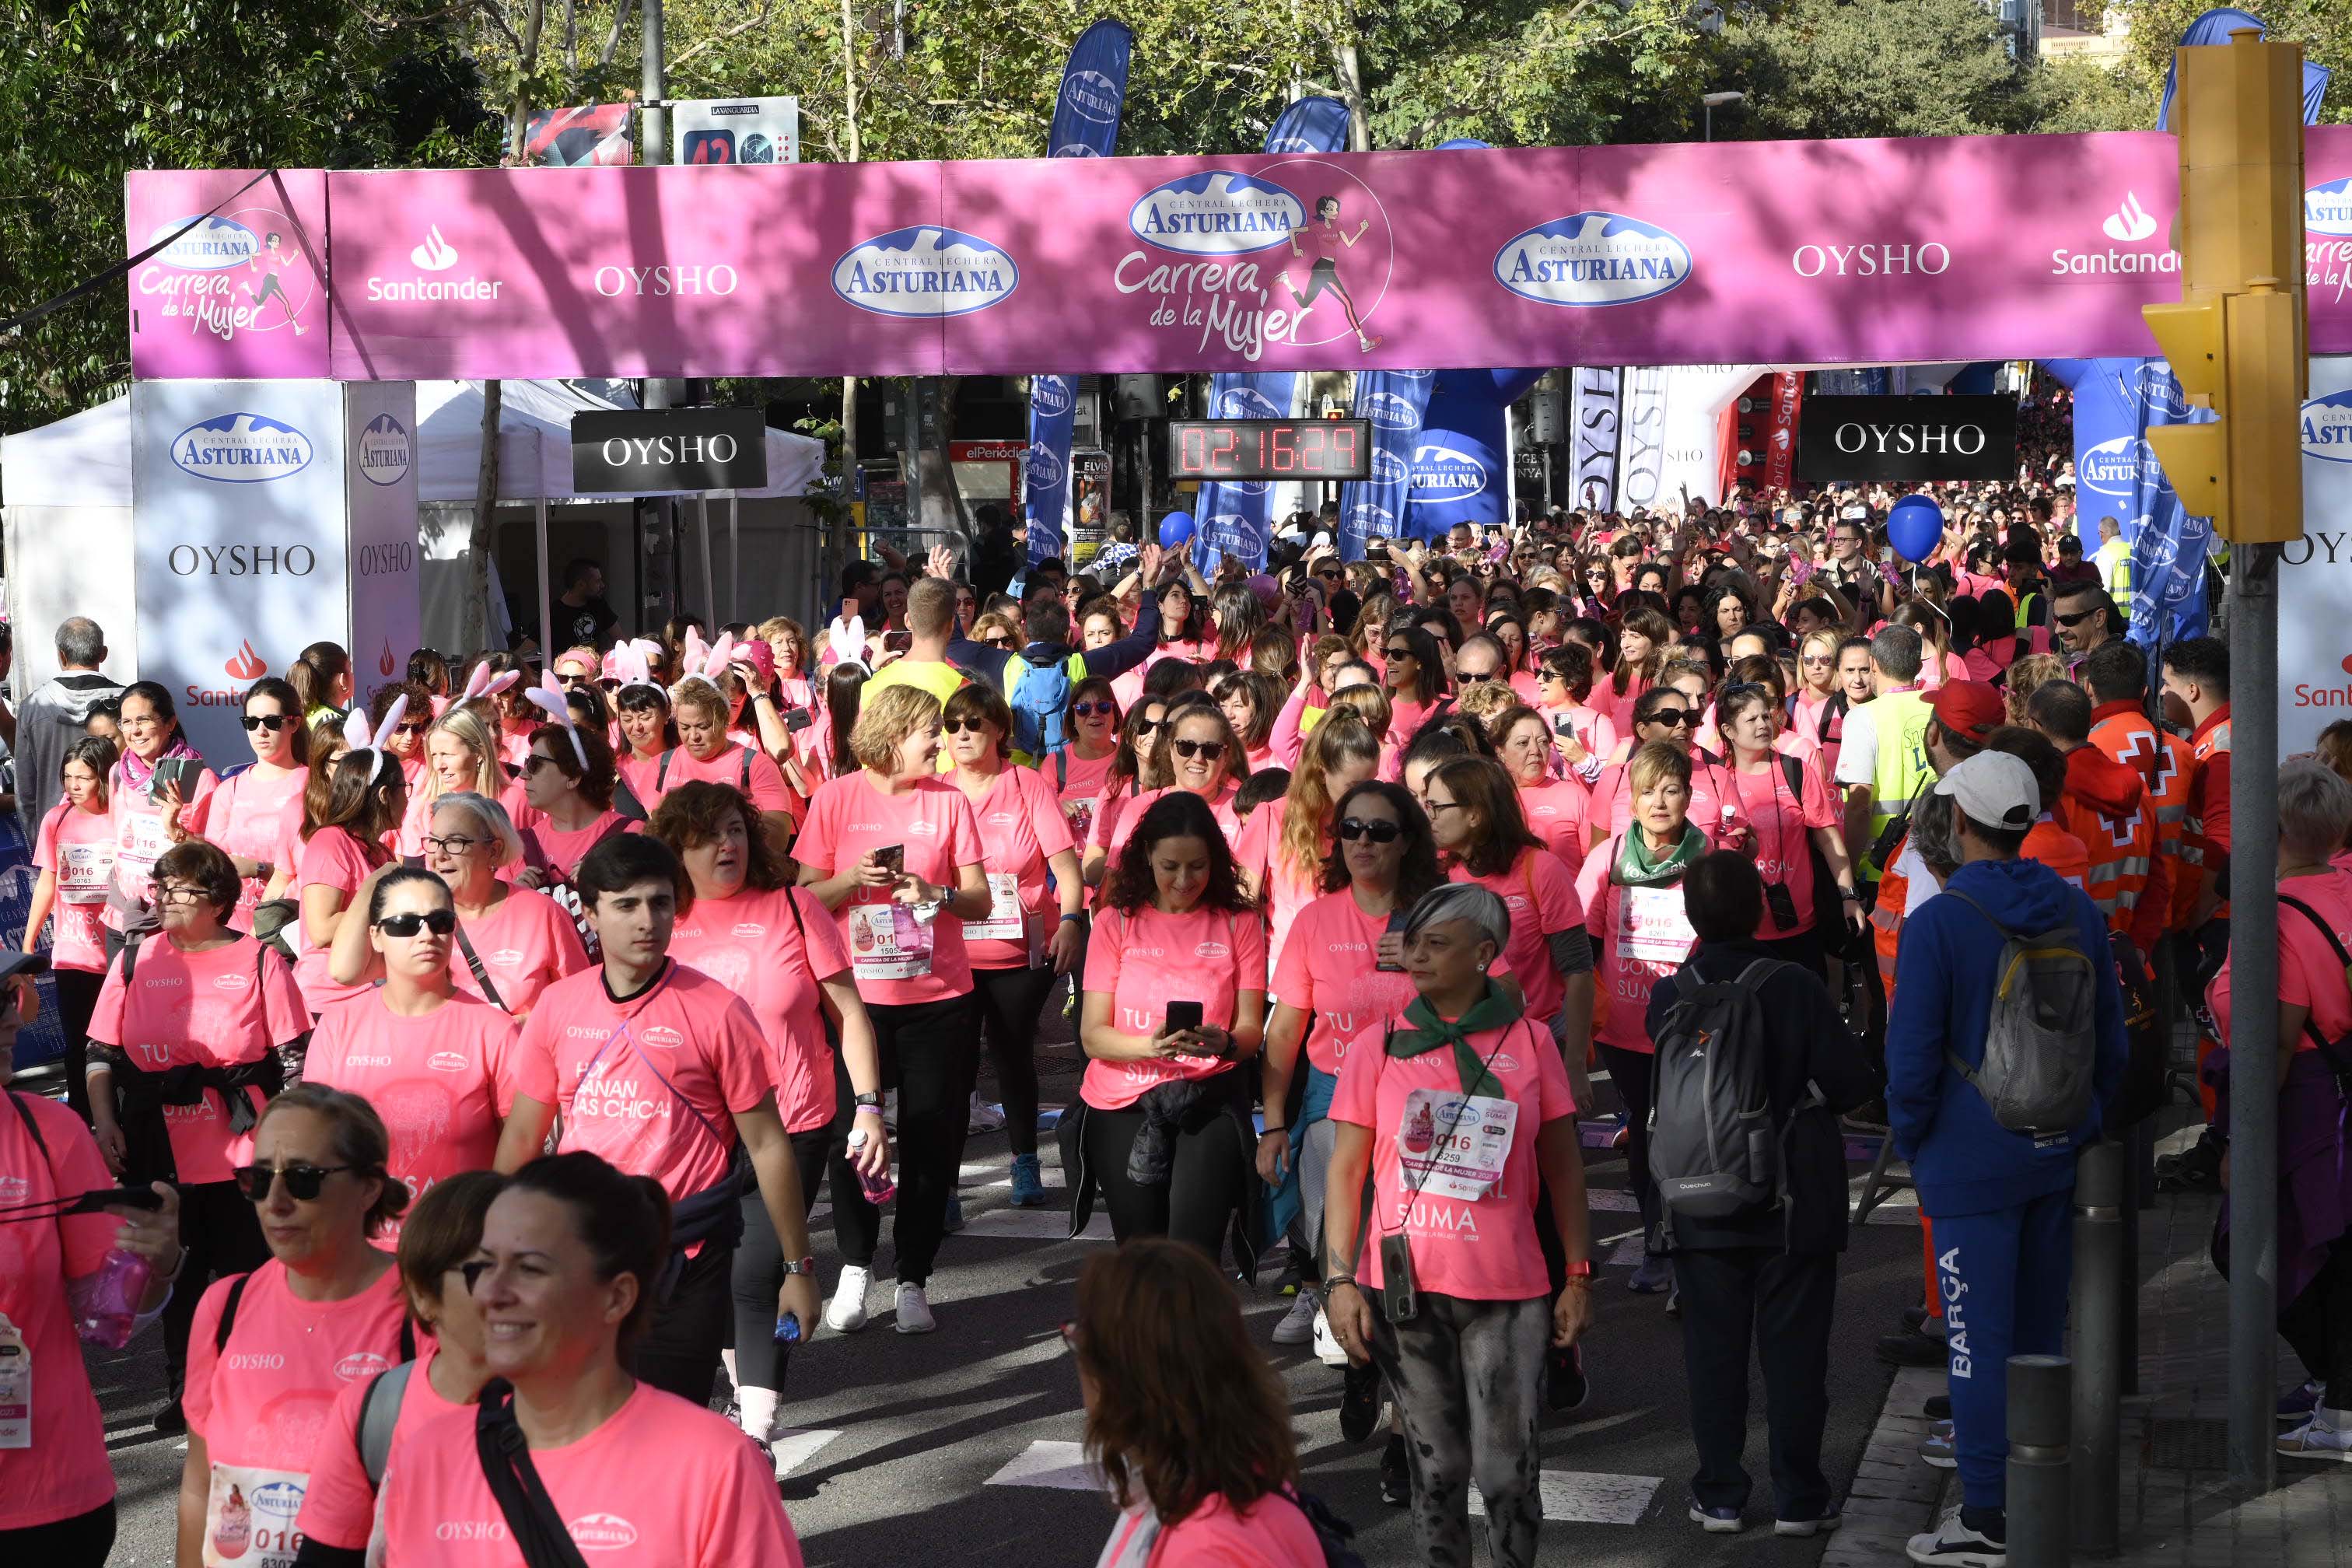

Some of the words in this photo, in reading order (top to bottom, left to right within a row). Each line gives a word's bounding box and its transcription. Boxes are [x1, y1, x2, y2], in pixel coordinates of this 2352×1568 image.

[1170, 200, 1225, 209] CENTRAL
[1230, 198, 1286, 208] LECHERA
[2305, 199, 2352, 222] ASTU
[1143, 203, 1292, 233] ASTURIANA
[1540, 243, 1600, 254] CENTRAL
[1607, 243, 1669, 253] LECHERA
[875, 257, 933, 267] CENTRAL
[939, 256, 998, 266] LECHERA
[1509, 248, 1677, 282] ASTURIANA
[1793, 242, 1950, 277] OYSHO
[2052, 249, 2182, 275] Santand
[139, 266, 231, 295] Carrera
[595, 264, 737, 296] OYSHO
[846, 260, 1004, 294] ASTURIANA
[1115, 250, 1259, 294] Carrera
[2325, 263, 2339, 285] la
[367, 277, 502, 301] Santander
[161, 296, 179, 317] de
[182, 296, 194, 317] la
[193, 292, 266, 340] Mujer
[1150, 296, 1177, 326] de
[1182, 294, 1202, 326] la
[1199, 289, 1314, 362] Mujer
[203, 436, 249, 445] CENTRAL
[1836, 422, 1985, 455] OYSHO
[182, 439, 303, 465] ASTURIANA
[362, 441, 407, 468] ASTURIANA
[603, 433, 737, 467] OYSHO
[1182, 428, 1356, 472] 02:16:29
[1083, 462, 1108, 471] ELVIS
[360, 541, 411, 576] OYSHO
[2280, 532, 2352, 565] OY
[168, 544, 316, 576] OYSHO
[1067, 780, 1094, 790] OYSHO
[848, 823, 882, 832] OYSHO
[72, 867, 93, 876] 016
[1645, 916, 1672, 928] 016
[1128, 947, 1164, 957] OYSHO
[1328, 942, 1368, 952] OYSHO
[146, 976, 183, 989] OYSHO
[1123, 1008, 1150, 1029] TU
[1325, 1011, 1353, 1032] TU
[567, 1026, 611, 1040] OYSHO
[644, 1034, 681, 1045] ASTURIANA
[140, 1044, 169, 1063] TU
[347, 1056, 391, 1066] OYSHO
[1486, 1111, 1507, 1121] SUMA
[1436, 1133, 1472, 1150] 016
[2034, 1139, 2053, 1149] SINCE
[2055, 1136, 2069, 1145] 1899
[1454, 1168, 1476, 1177] MUJER
[1679, 1181, 1711, 1190] Quechua
[1397, 1203, 1476, 1232] SUMA
[1939, 1247, 1972, 1379] BARÇA
[229, 1353, 285, 1370] OYSHO
[436, 1521, 506, 1541] OYSHO
